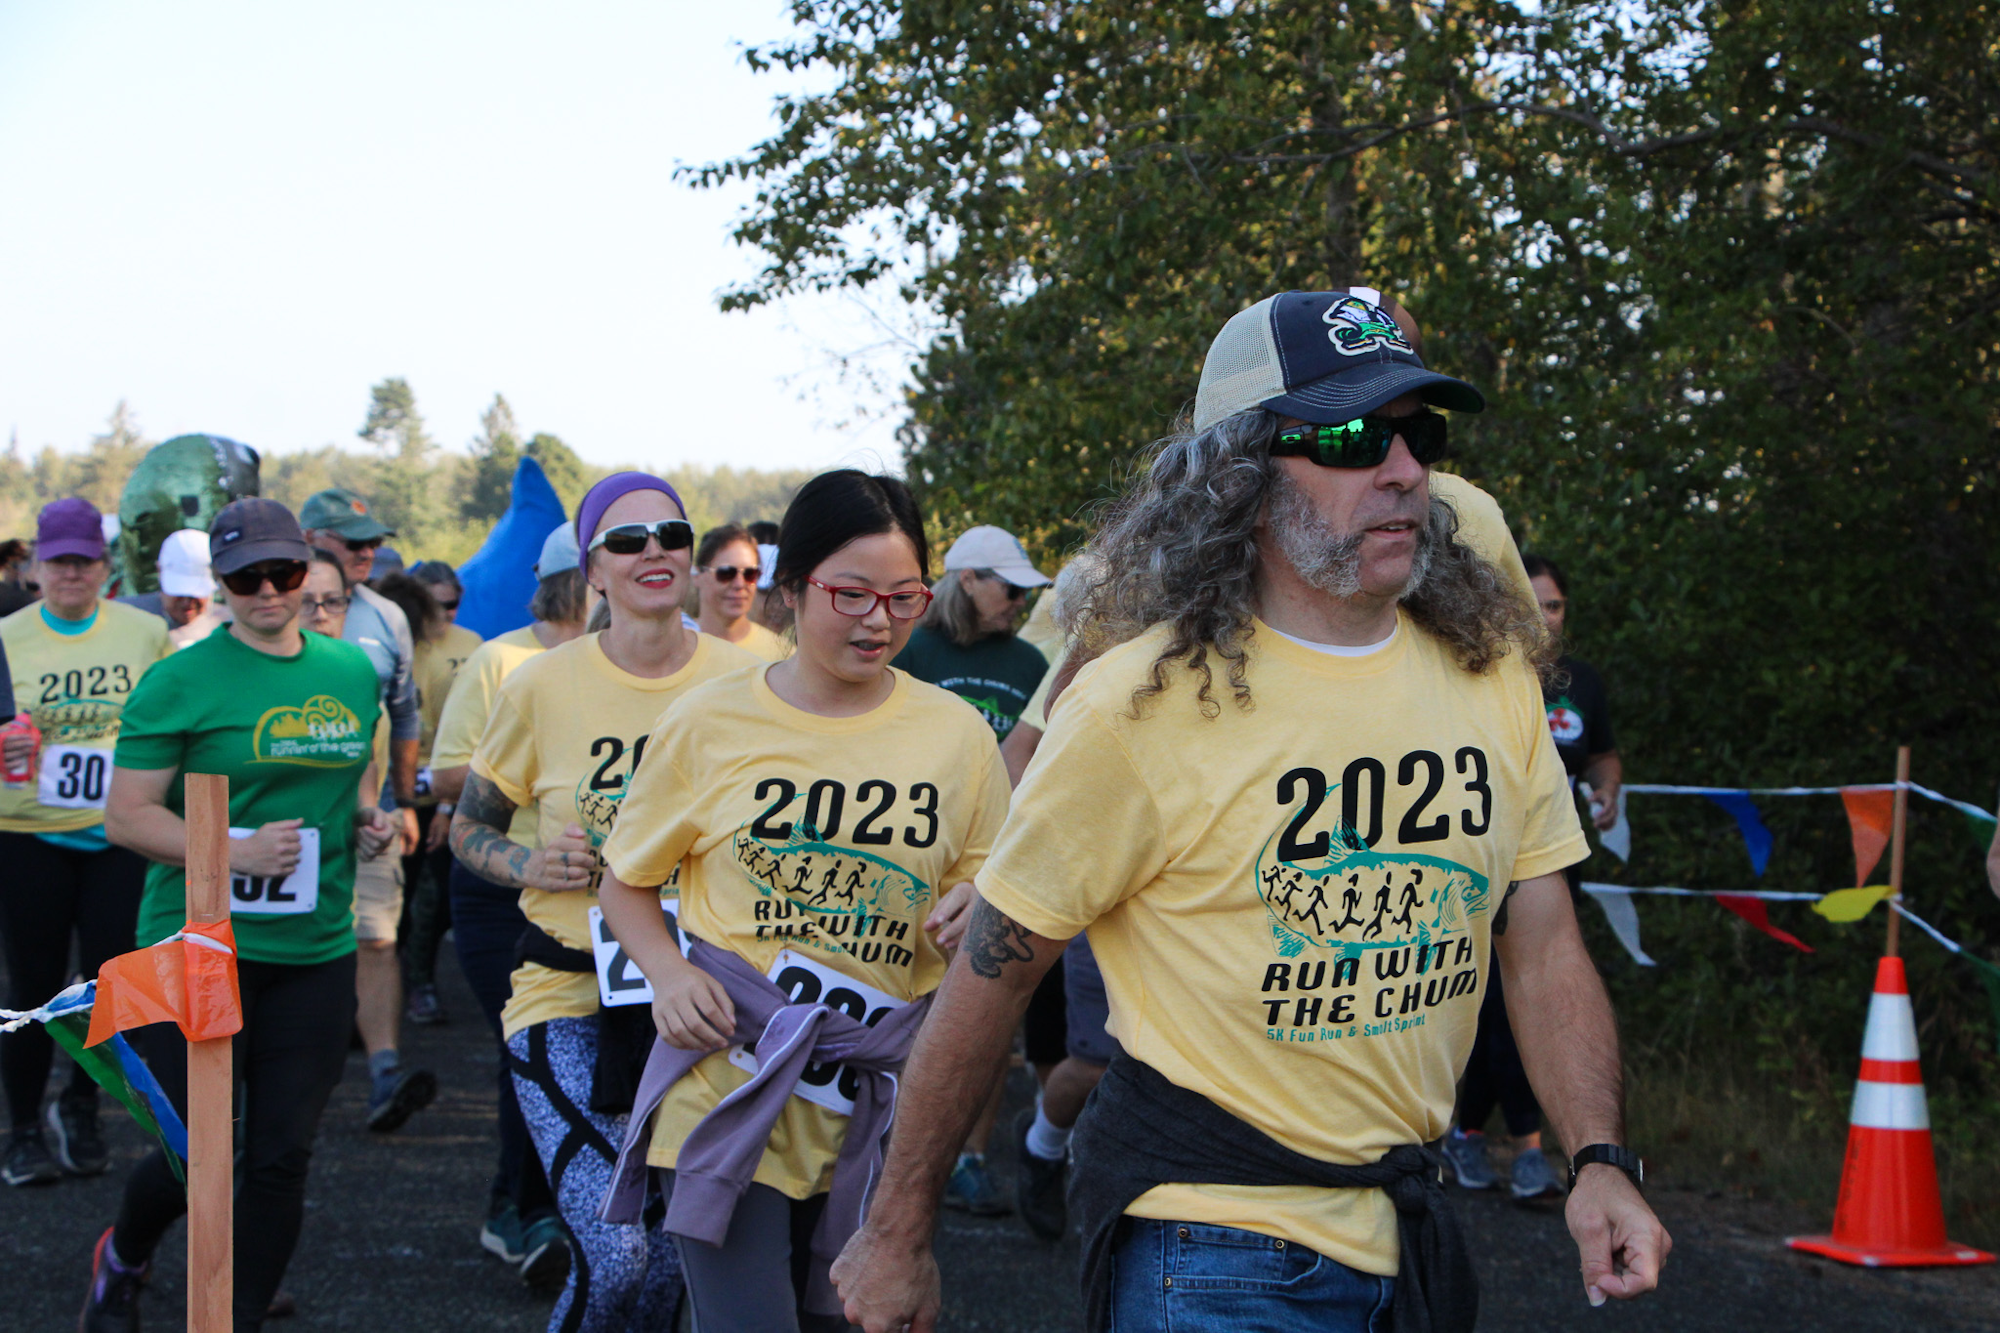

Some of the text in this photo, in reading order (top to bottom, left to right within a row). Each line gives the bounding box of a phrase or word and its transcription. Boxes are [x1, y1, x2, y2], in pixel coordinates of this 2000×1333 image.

[39, 664, 132, 704] 2023
[58, 752, 105, 801] 30
[749, 777, 939, 849] 2023
[1276, 746, 1492, 862] 2023
[754, 899, 909, 941] RU WITH
[755, 921, 819, 938] THE
[1261, 934, 1473, 992] RUN WITH
[1262, 967, 1477, 1027] THE CHUM
[1267, 1012, 1426, 1042] 5K Fun Run & Smolt Sprint
